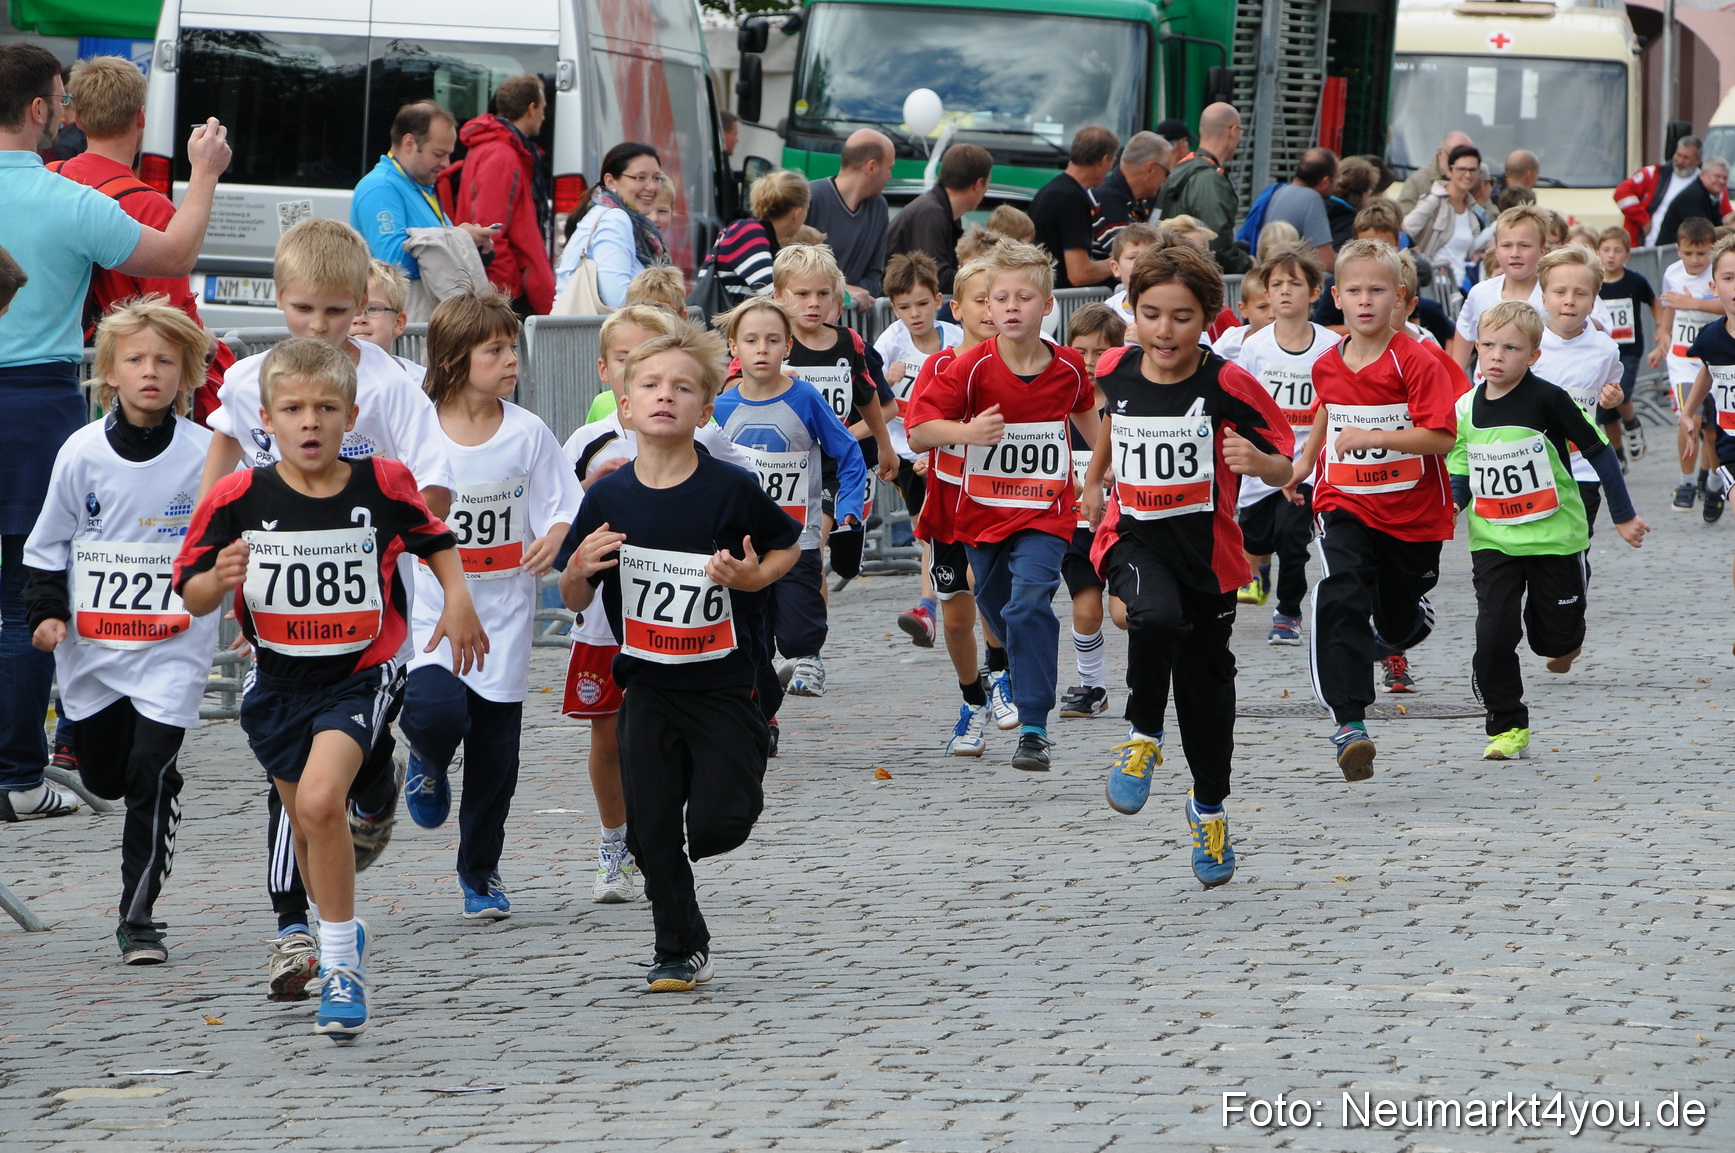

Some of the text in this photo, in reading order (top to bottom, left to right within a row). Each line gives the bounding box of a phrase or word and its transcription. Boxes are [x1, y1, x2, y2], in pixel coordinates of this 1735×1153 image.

[217, 280, 239, 297] NM
[1678, 325, 1703, 343] 70
[804, 374, 841, 383] Neumarkt
[1283, 411, 1313, 424] obias
[1354, 413, 1400, 425] Neumarkt
[1007, 431, 1055, 441] Neumarkt
[1112, 424, 1192, 439] PARTL Neumarkt
[982, 443, 1060, 476] 7090
[1118, 441, 1199, 481] 7103
[1487, 447, 1530, 462] Neumarkt
[755, 458, 797, 470] Neumarkt
[1356, 469, 1389, 484] Luca
[1474, 459, 1541, 497] 7261
[461, 489, 511, 505] Neumarkt
[991, 480, 1044, 498] Vincent
[1136, 490, 1173, 508] Nino
[1498, 502, 1524, 516] Tim
[76, 551, 171, 565] PARTL Neumarkt
[248, 542, 358, 557] PARTL Neumarkt
[622, 556, 660, 573] PARTL
[87, 571, 173, 612] 7227
[258, 559, 367, 608] 7085
[632, 577, 725, 625] 7276
[95, 618, 168, 637] Jonathan
[287, 620, 343, 641] Kilian
[646, 628, 707, 654] Tommy
